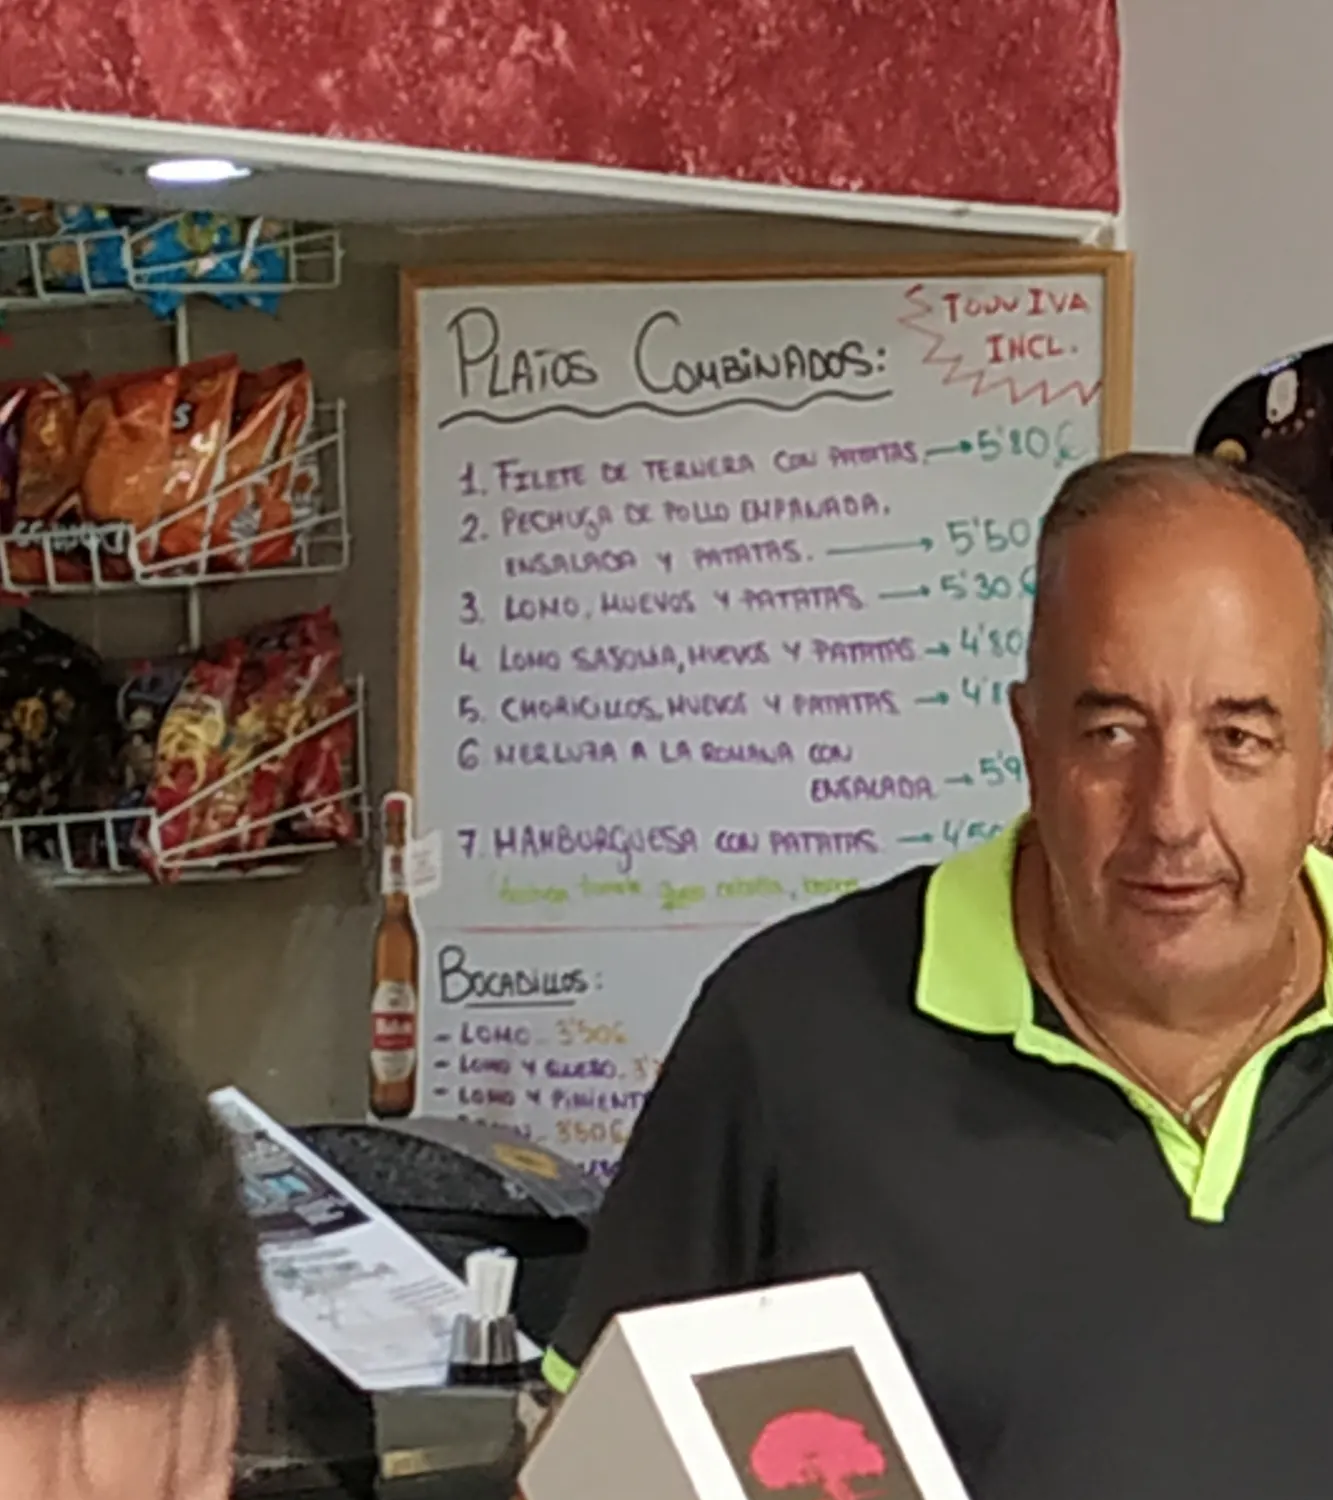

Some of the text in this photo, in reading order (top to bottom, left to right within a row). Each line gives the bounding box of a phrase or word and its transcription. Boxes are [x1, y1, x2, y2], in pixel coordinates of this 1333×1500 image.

[1026, 288, 1090, 316] IVA
[447, 306, 886, 398] PLATOS COMBINADOS:
[986, 333, 1079, 364] INCL.
[494, 457, 586, 492] FILETE
